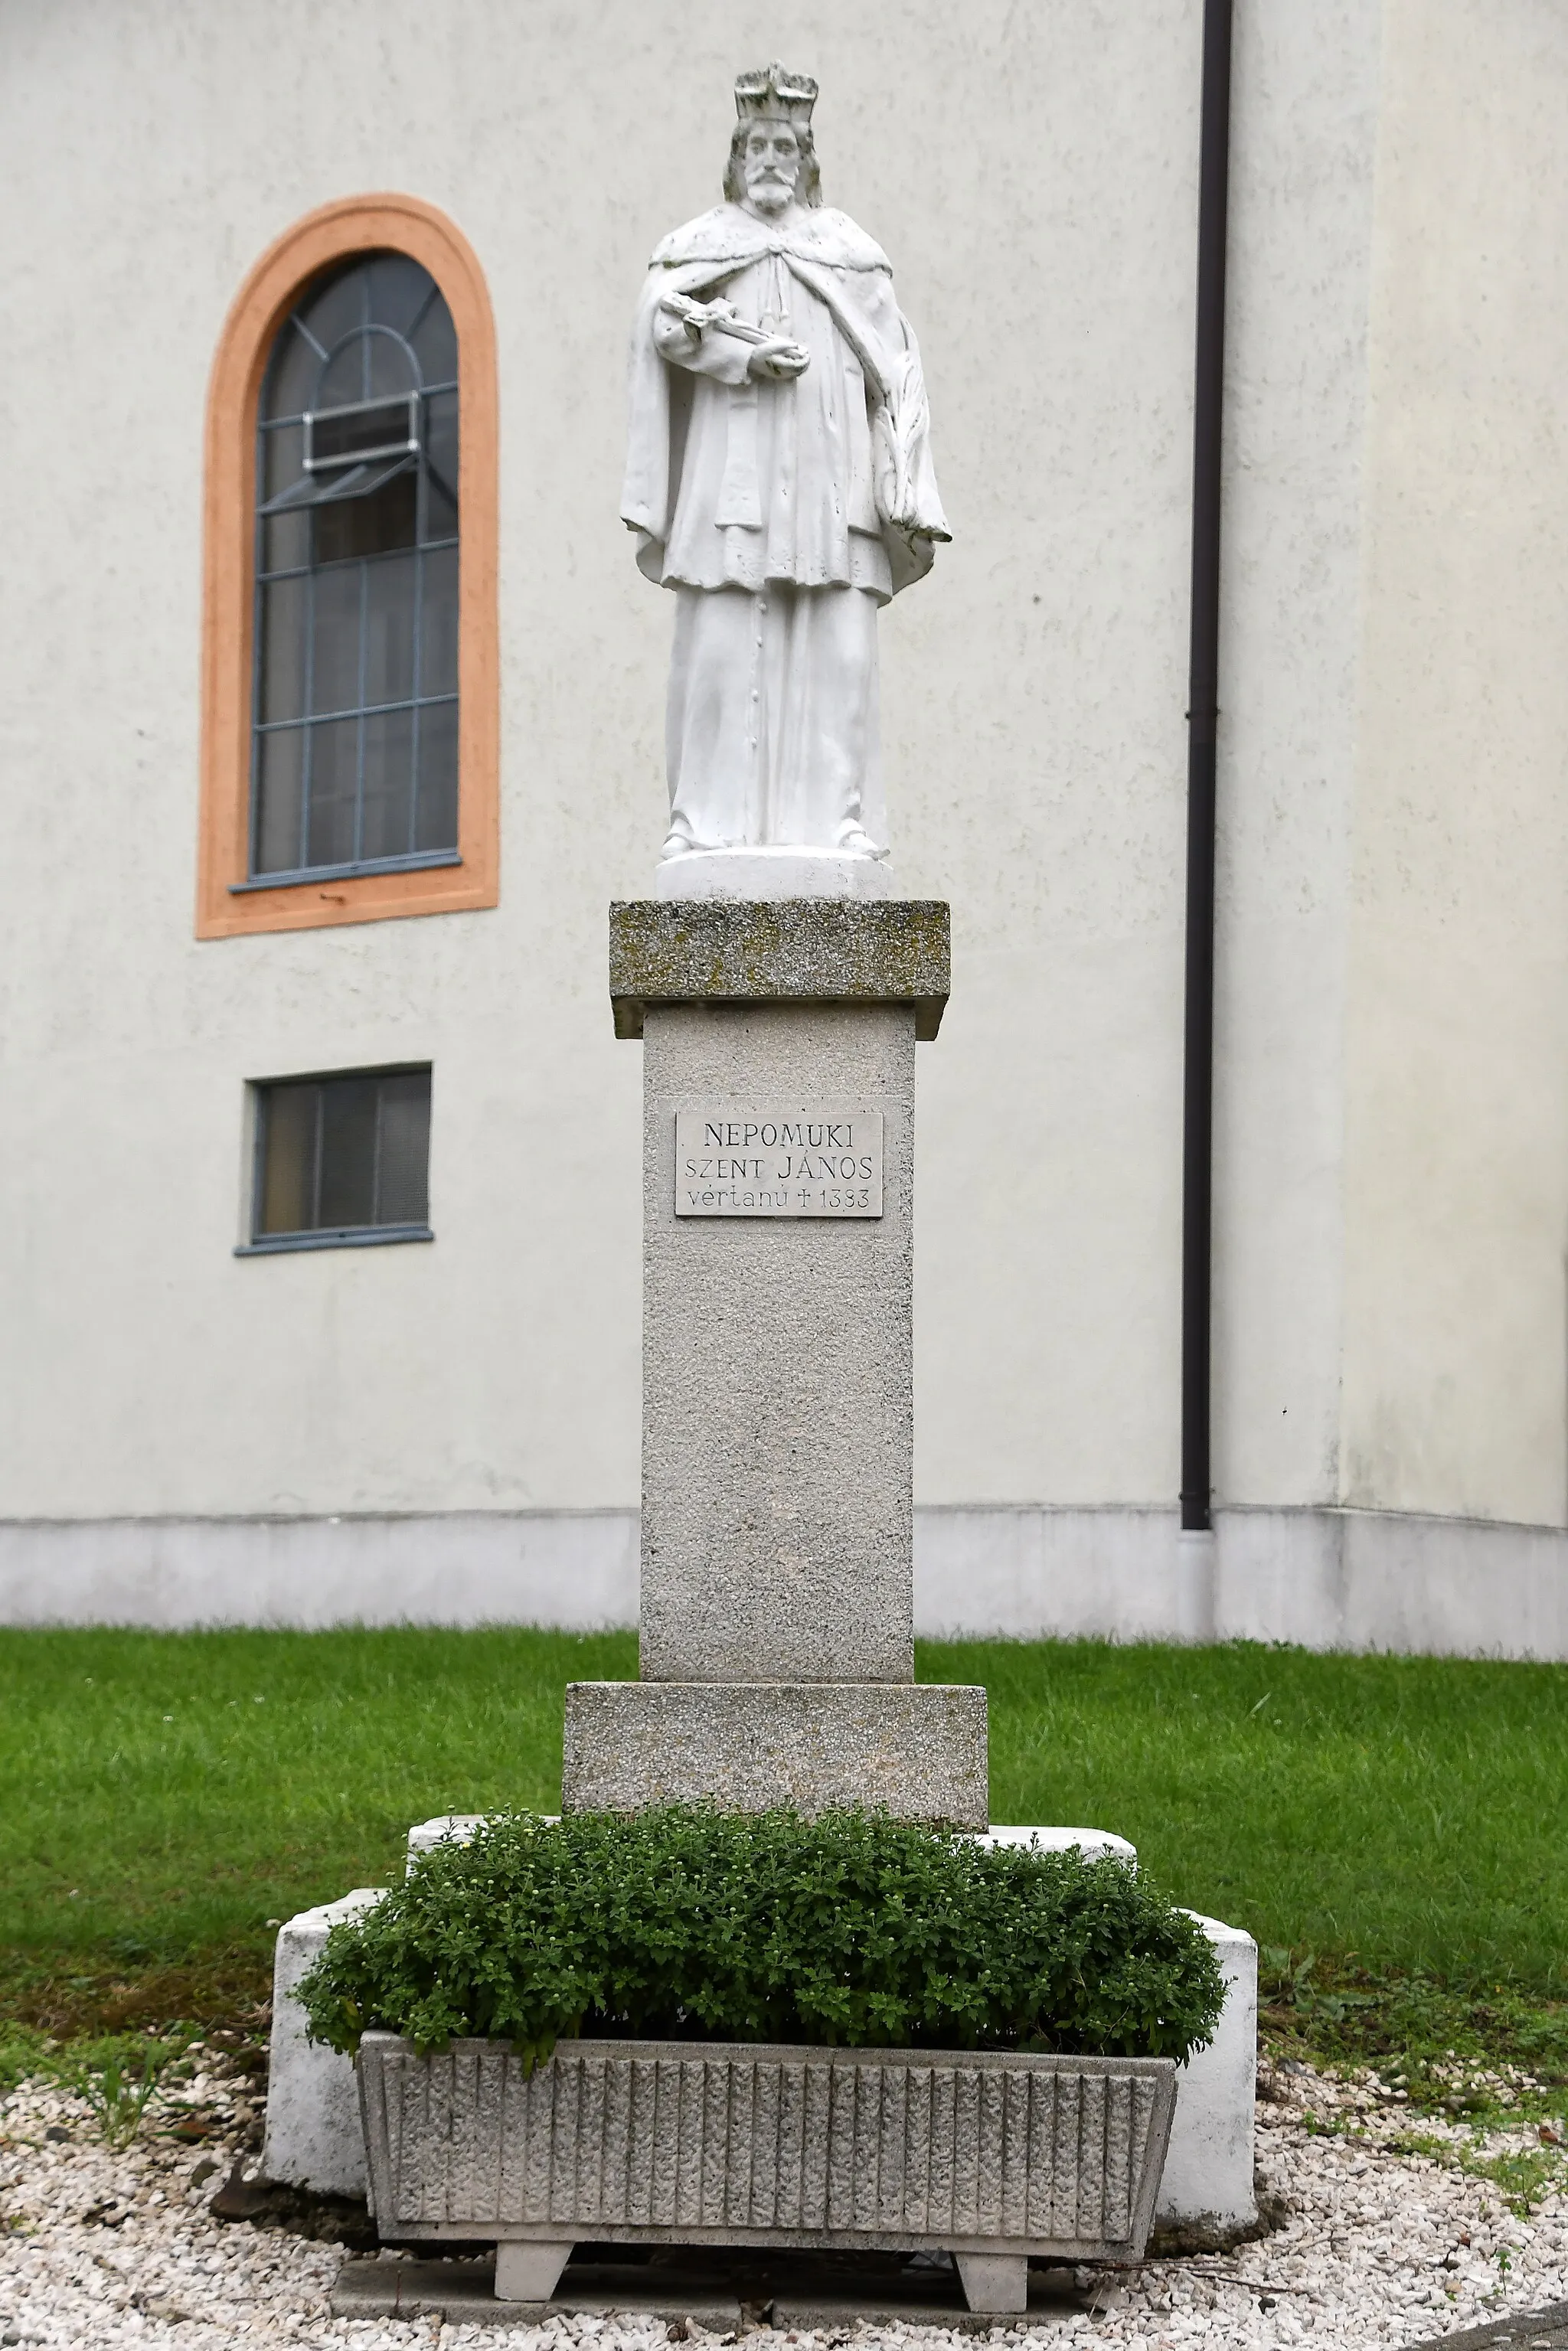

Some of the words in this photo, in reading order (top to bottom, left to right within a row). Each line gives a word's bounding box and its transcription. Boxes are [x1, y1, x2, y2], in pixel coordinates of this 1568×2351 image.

[704, 1122, 854, 1148] NEPOMUKI
[685, 1158, 765, 1179] SZENT
[778, 1149, 873, 1180] JÁNOS
[687, 1184, 788, 1207] vértanú
[819, 1188, 870, 1208] 1383
